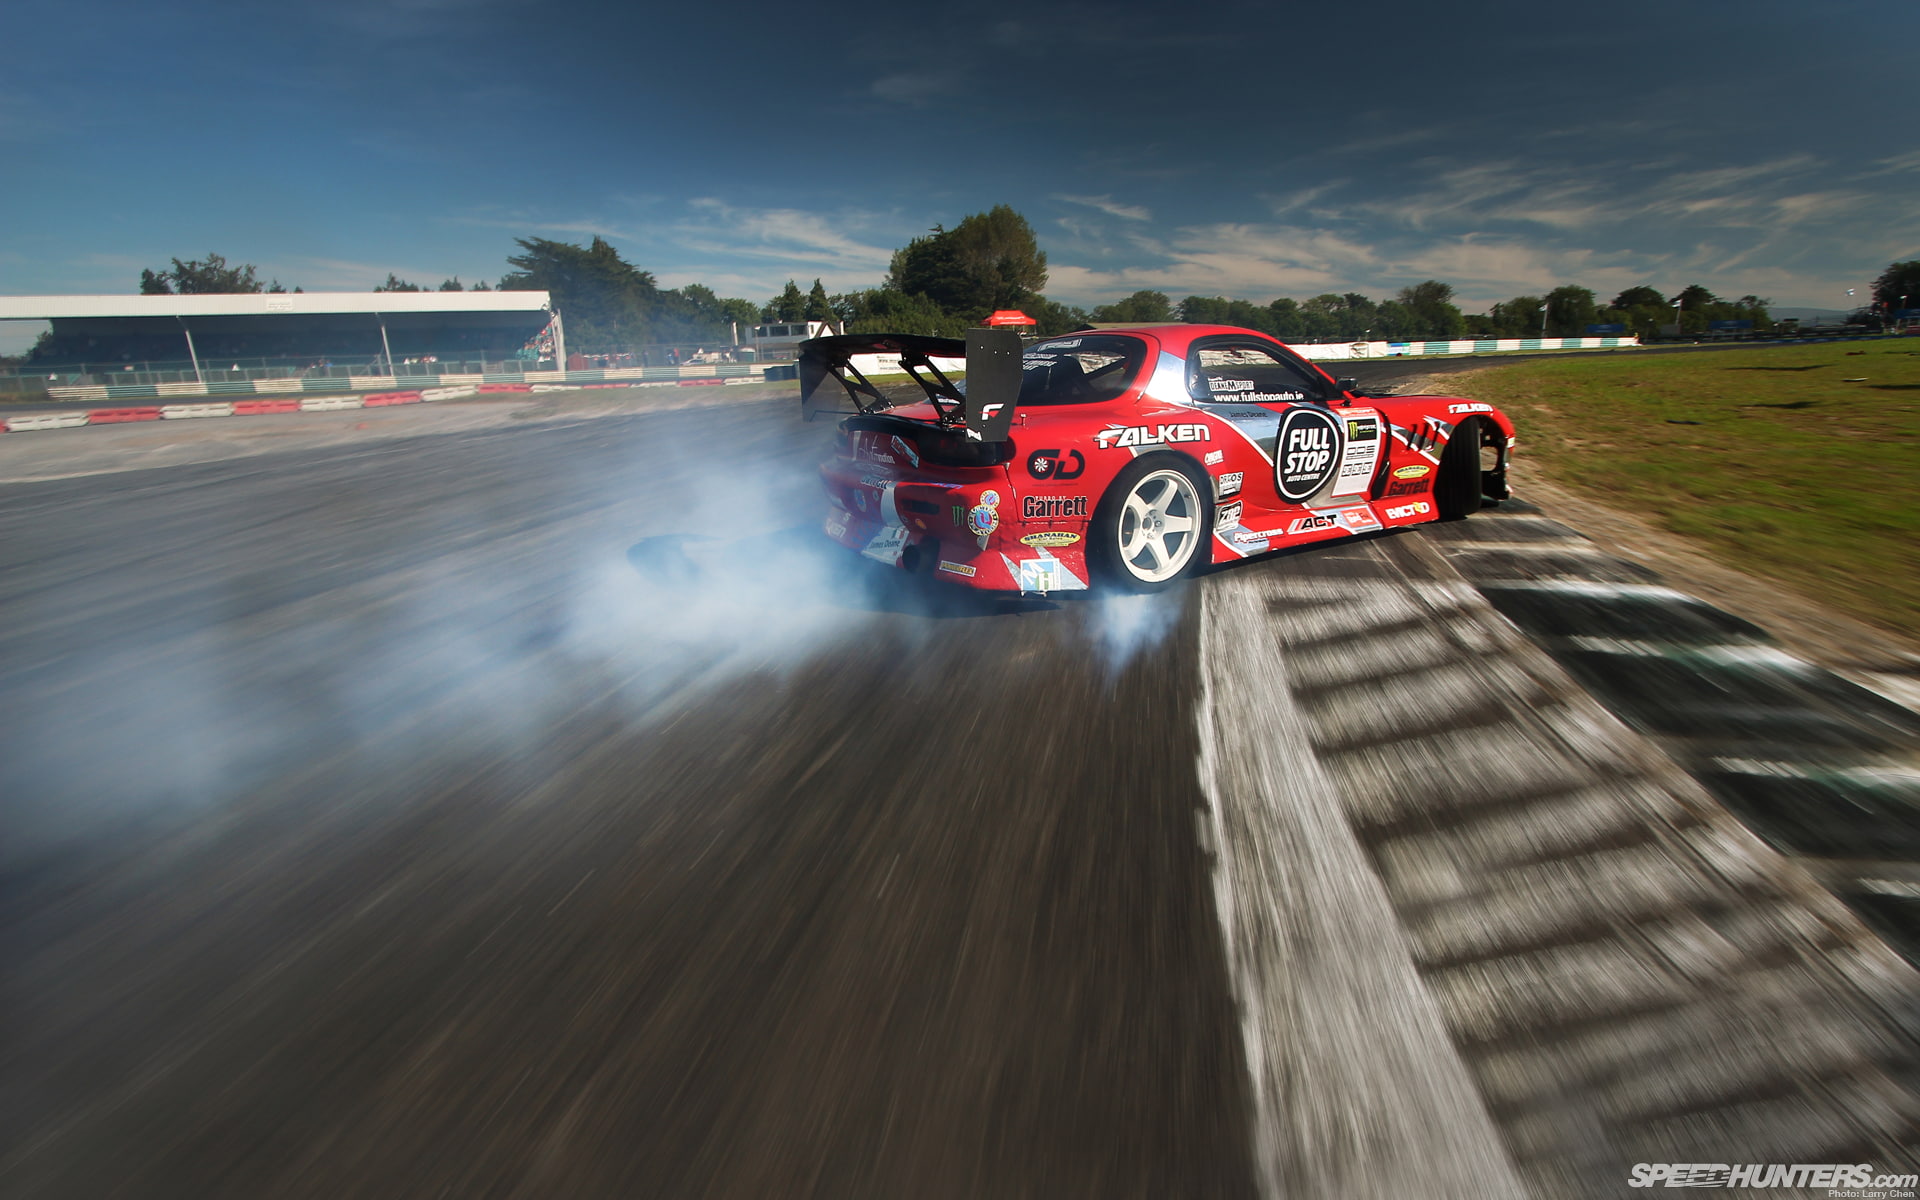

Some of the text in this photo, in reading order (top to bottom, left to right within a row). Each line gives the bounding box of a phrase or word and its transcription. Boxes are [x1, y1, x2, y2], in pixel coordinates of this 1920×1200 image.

[1448, 403, 1494, 414] FALKEN
[1093, 424, 1211, 449] FALKEN
[1289, 428, 1330, 452] FULL
[1389, 479, 1429, 496] Garrett
[1022, 496, 1088, 518] Garrett
[1301, 514, 1337, 529] ACT
[1024, 532, 1077, 541] SHANAHAN
[1233, 528, 1284, 543] Pipercross
